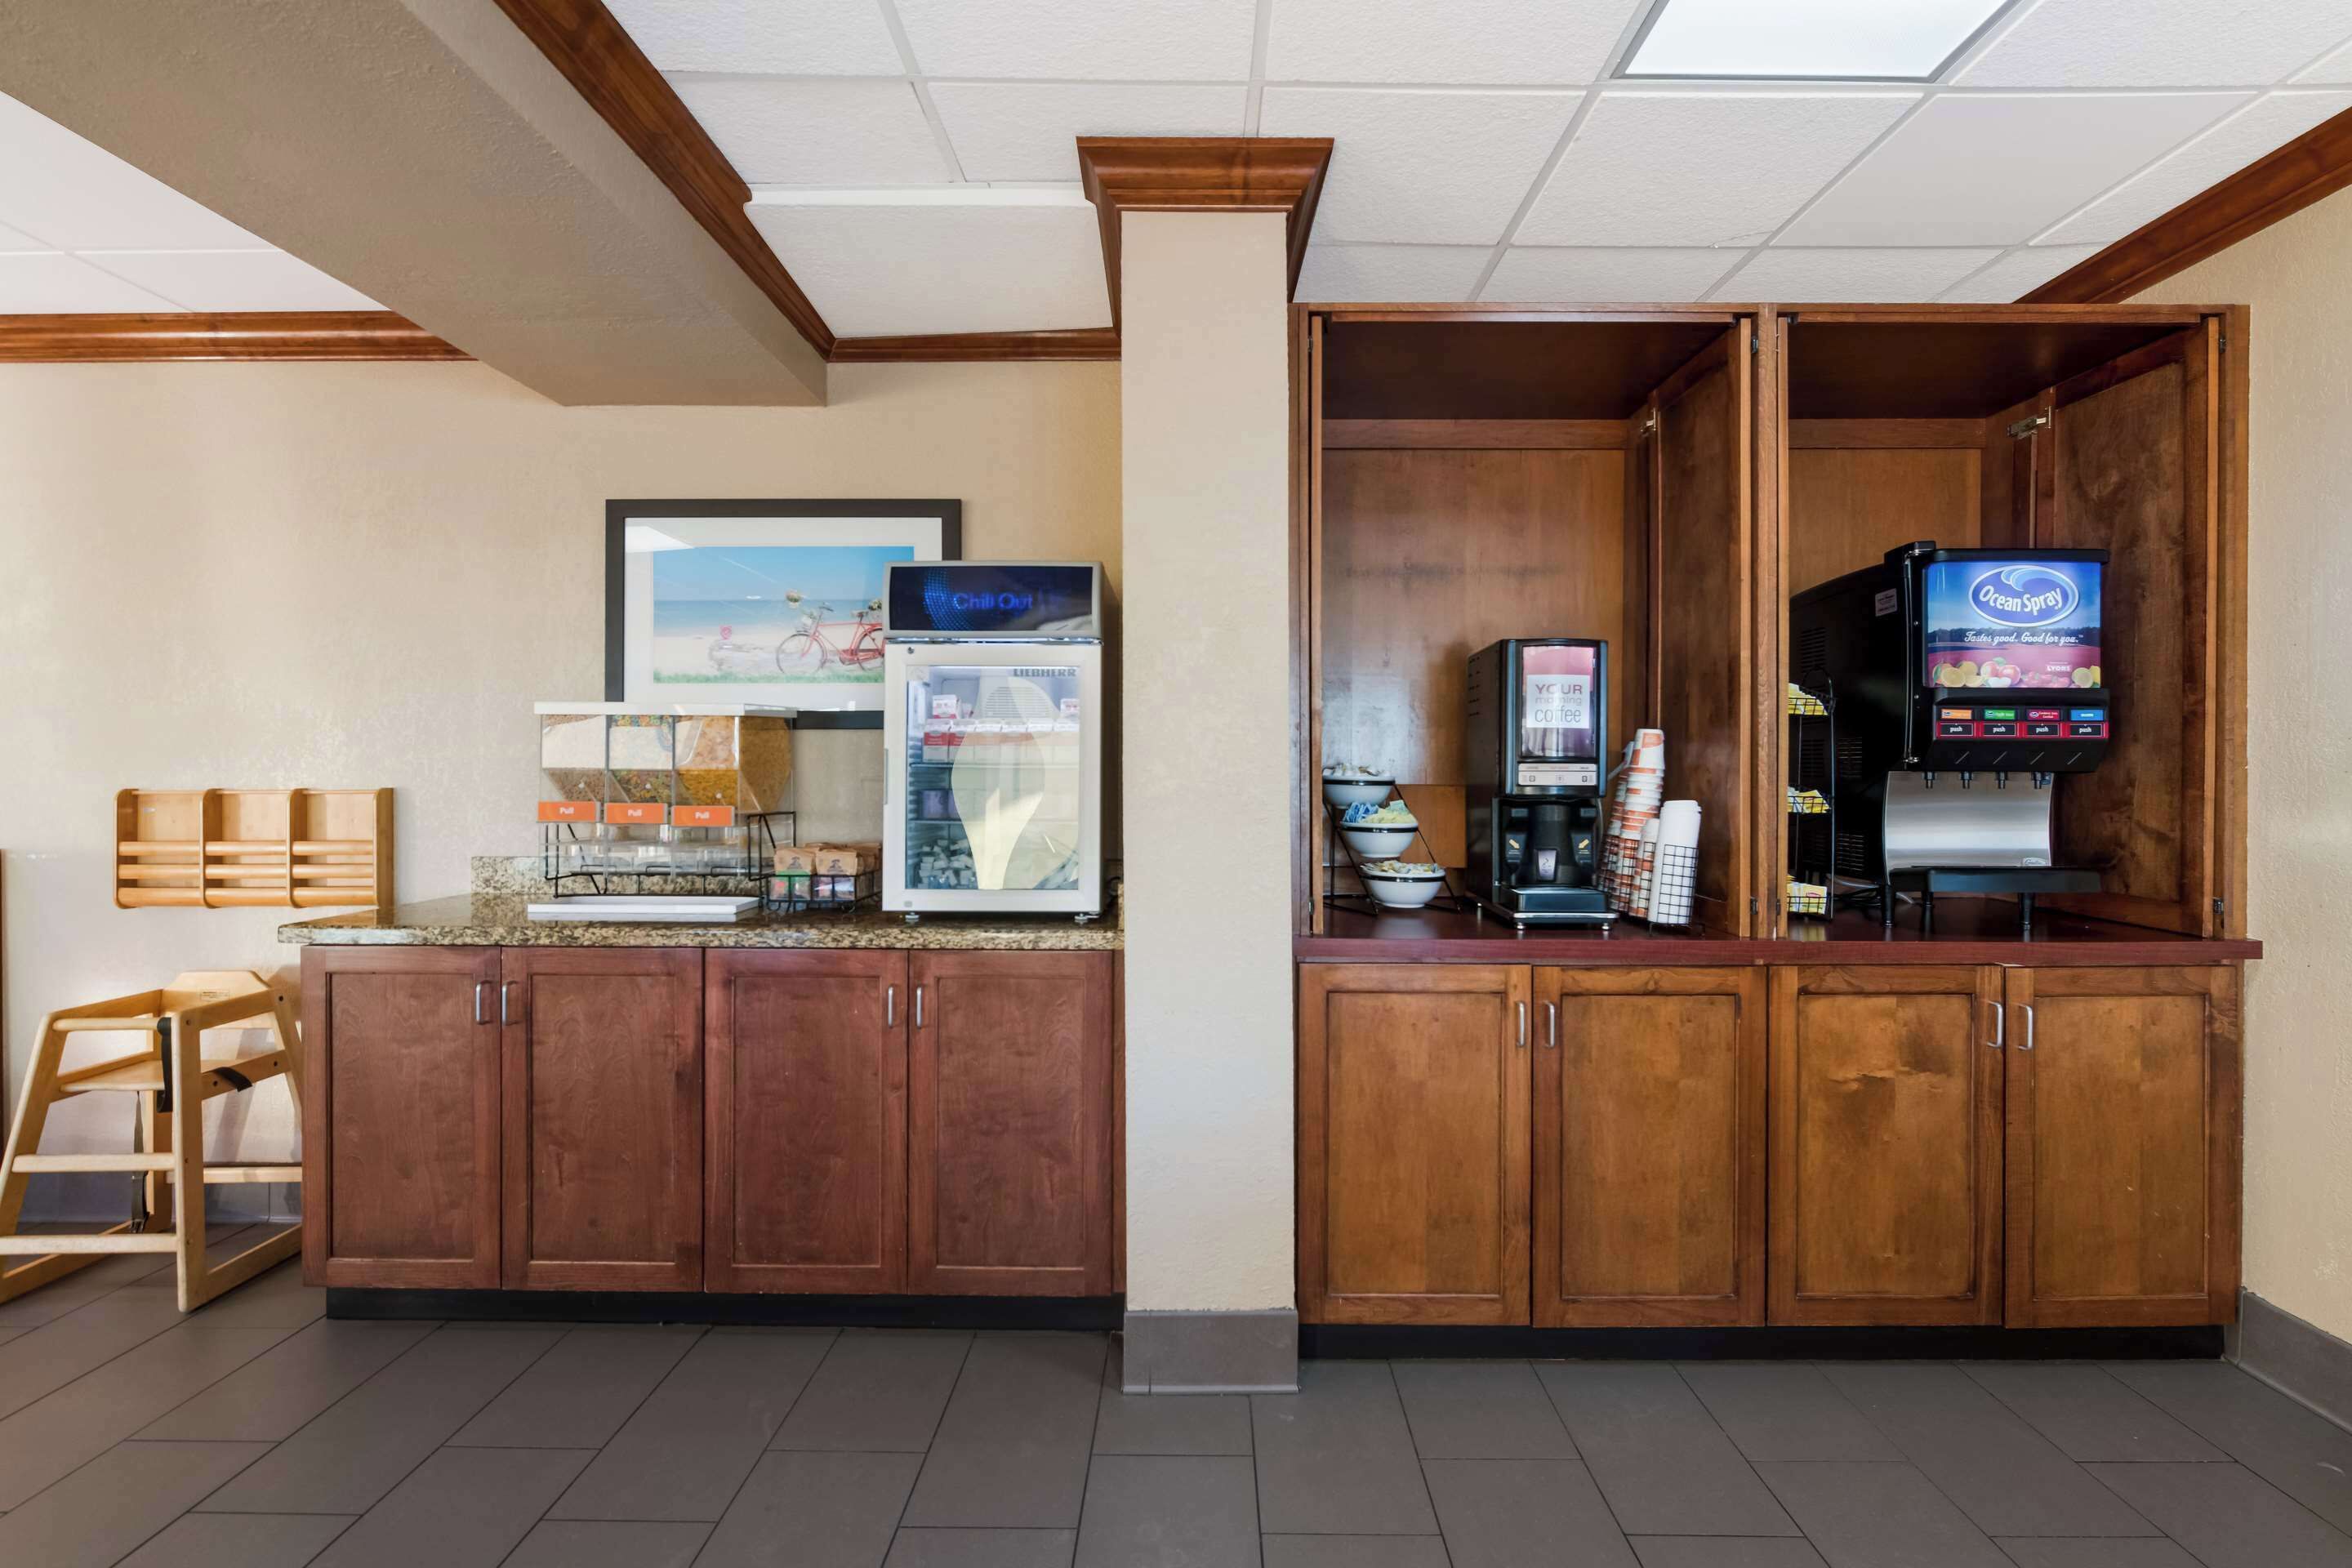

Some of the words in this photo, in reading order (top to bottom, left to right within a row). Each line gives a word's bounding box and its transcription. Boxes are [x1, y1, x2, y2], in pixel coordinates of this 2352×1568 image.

[953, 592, 994, 610] Chill
[998, 591, 1033, 610] Out
[1979, 585, 2022, 612] Ocean
[2022, 587, 2063, 616] Spray
[1964, 630, 1992, 642] Tastes
[1993, 632, 2018, 646] good.
[2021, 631, 2045, 642] Good
[2044, 632, 2059, 644] for
[1013, 668, 1076, 677] LIEBHERR
[1535, 697, 1582, 706] moning
[1949, 725, 1963, 733] push
[1993, 726, 2006, 734] push
[2036, 725, 2049, 734] push
[2079, 726, 2092, 734] push
[559, 806, 575, 815] Pull
[627, 808, 643, 817] Pull
[695, 811, 710, 820] Pull
